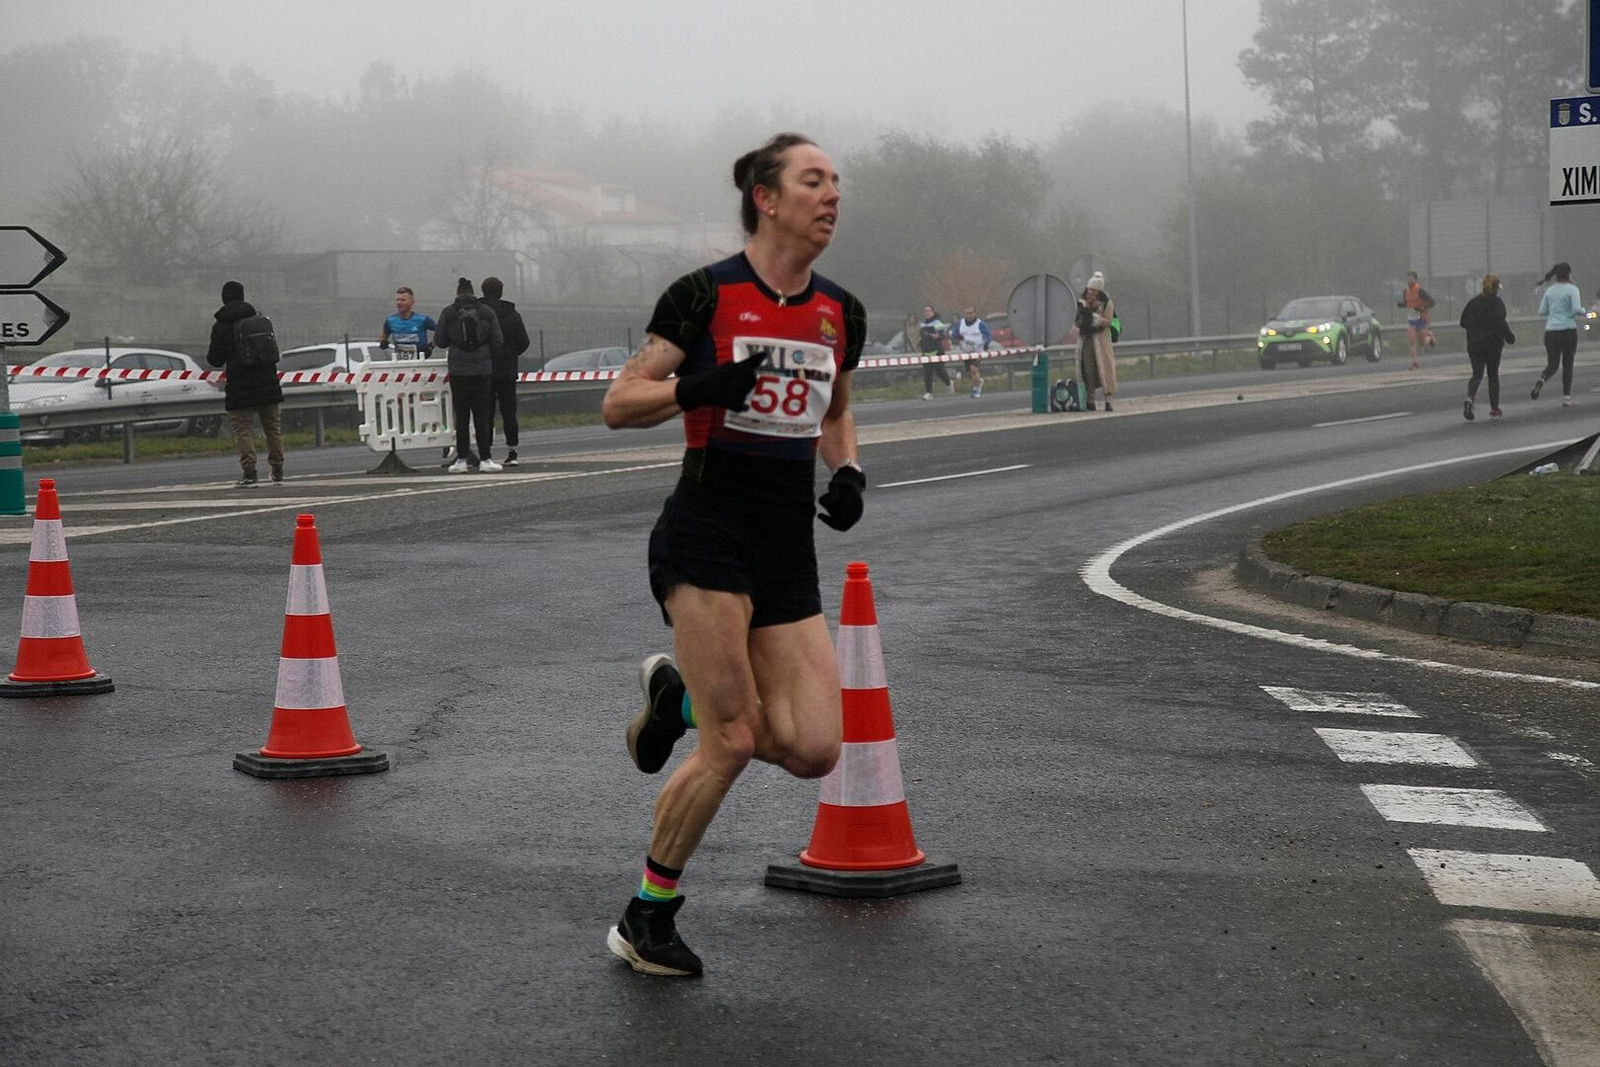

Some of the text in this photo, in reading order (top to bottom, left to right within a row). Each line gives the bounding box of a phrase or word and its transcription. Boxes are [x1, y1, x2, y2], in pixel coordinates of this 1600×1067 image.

[1579, 102, 1597, 123] S.
[1562, 165, 1600, 196] XIM
[2, 322, 30, 338] ES
[750, 375, 811, 417] 58
